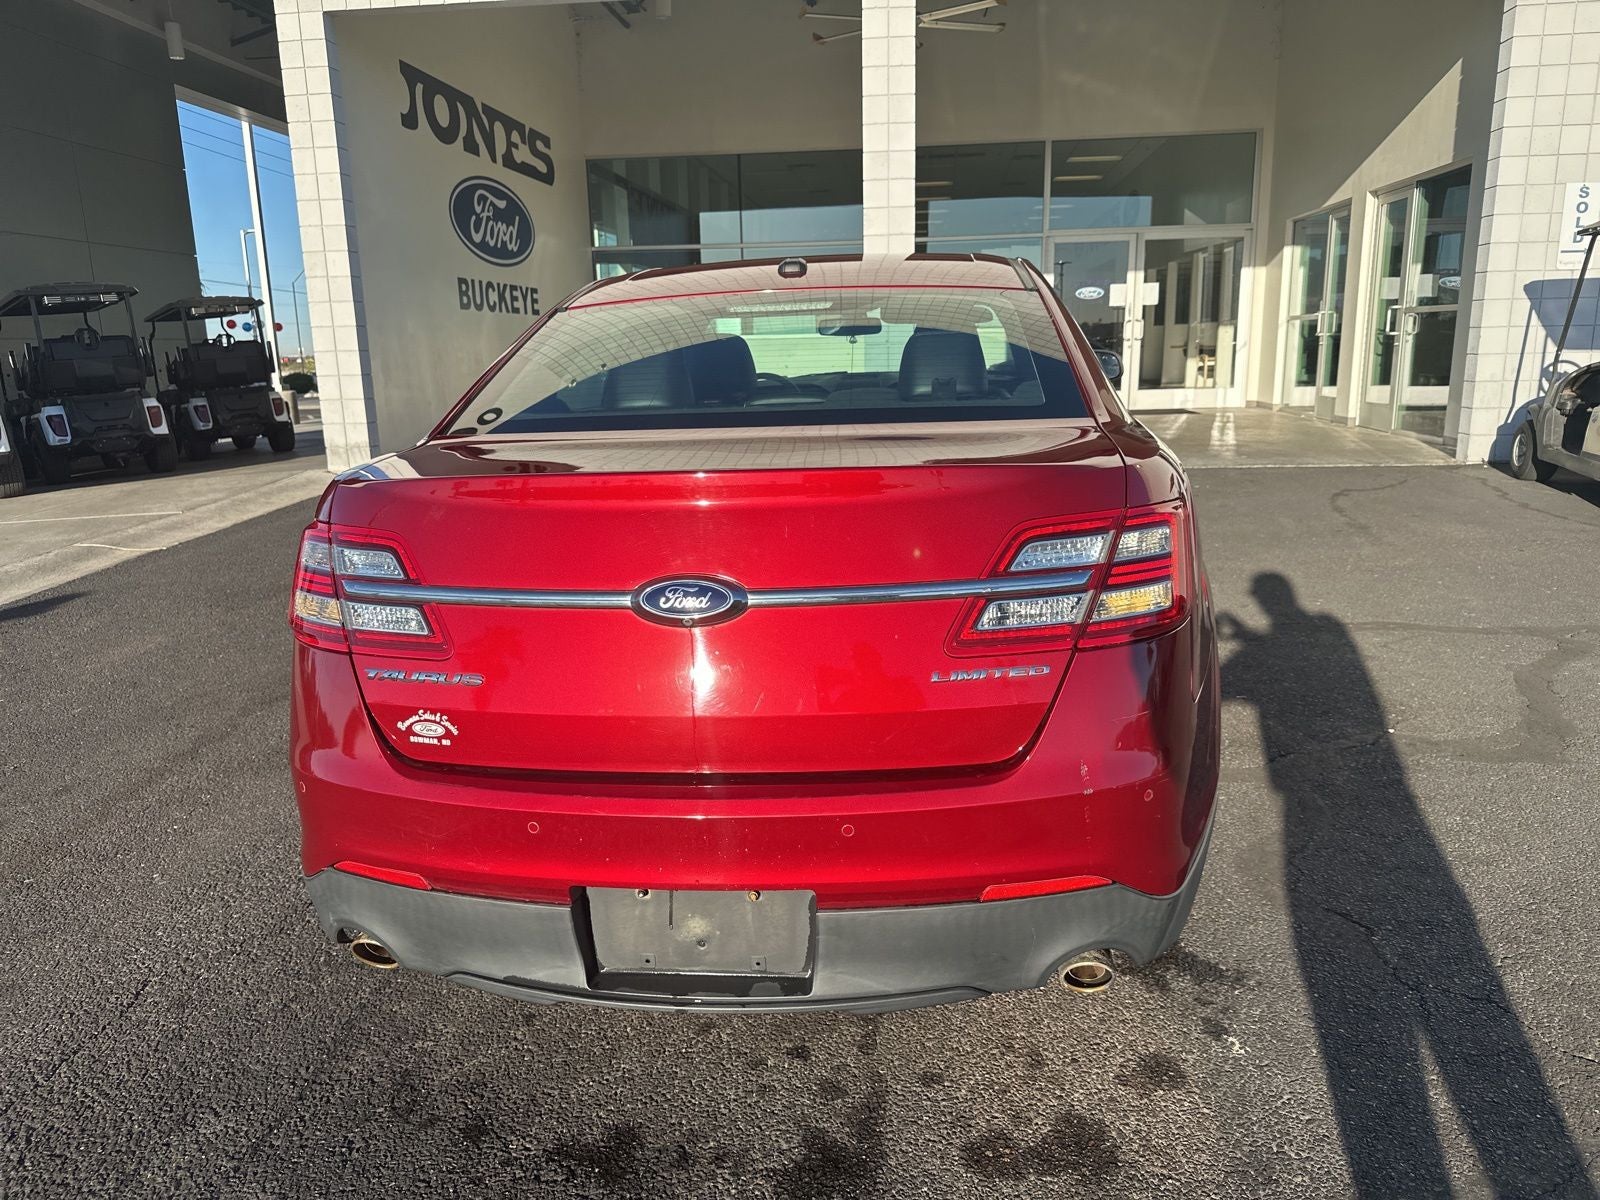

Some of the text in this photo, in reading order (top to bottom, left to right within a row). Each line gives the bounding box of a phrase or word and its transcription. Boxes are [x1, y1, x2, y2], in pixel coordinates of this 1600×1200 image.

[399, 59, 555, 186] JONES
[470, 189, 521, 252] Ford
[457, 277, 540, 316] BUCKEYE
[659, 586, 712, 608] Ford
[364, 668, 484, 686] TAURUS
[930, 665, 1050, 682] LIMITED
[418, 709, 436, 720] Sales
[440, 715, 459, 735] Service
[419, 724, 439, 733] Ford
